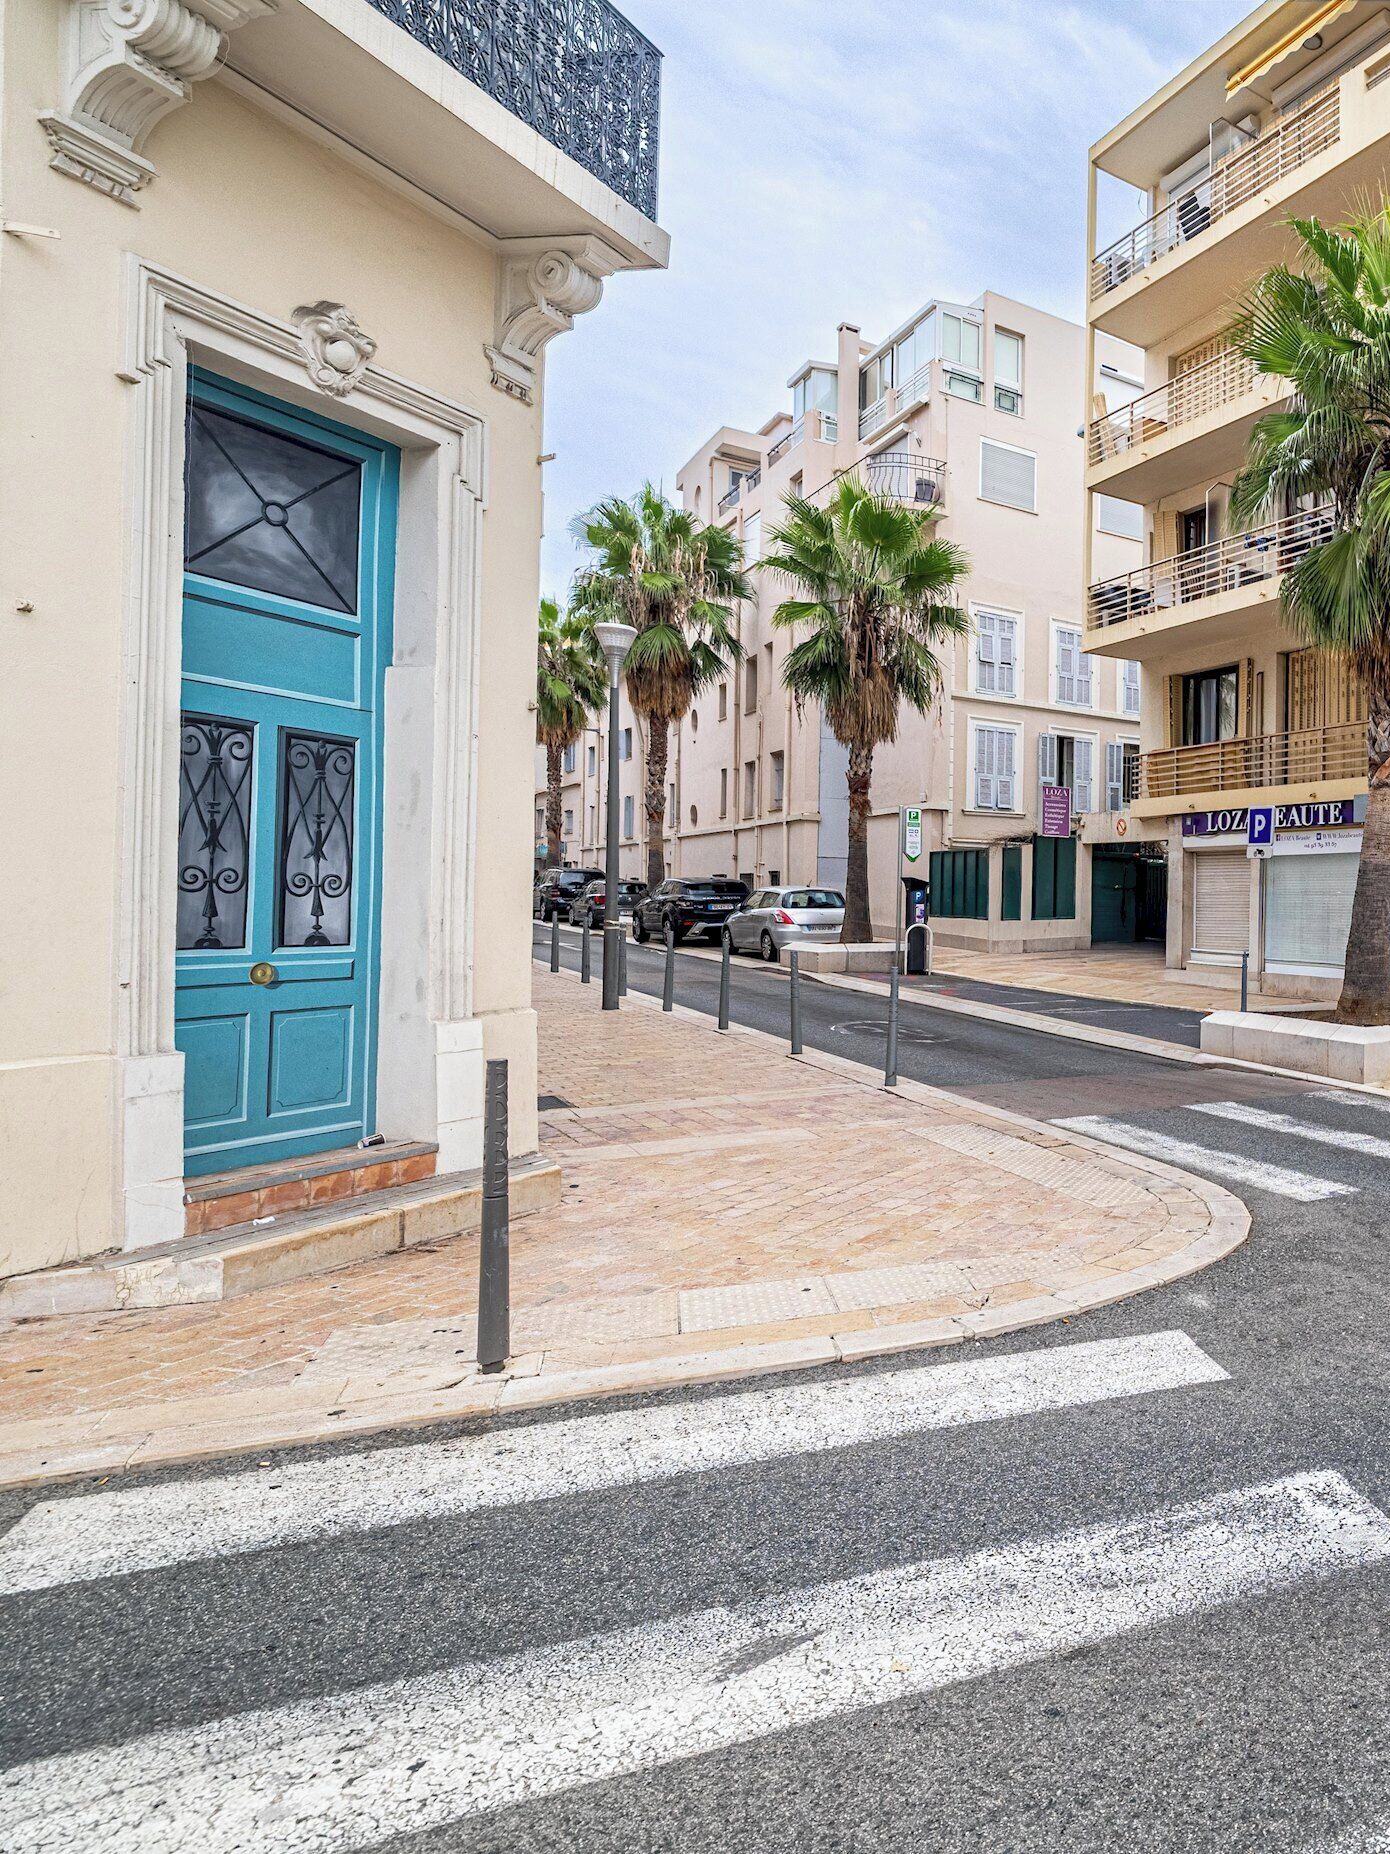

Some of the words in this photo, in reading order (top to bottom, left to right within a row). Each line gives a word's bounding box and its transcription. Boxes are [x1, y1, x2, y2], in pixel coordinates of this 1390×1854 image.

[1045, 788, 1068, 797] LOZA
[1275, 803, 1343, 828] EAUTE
[1254, 814, 1266, 838] P
[915, 892, 922, 901] P
